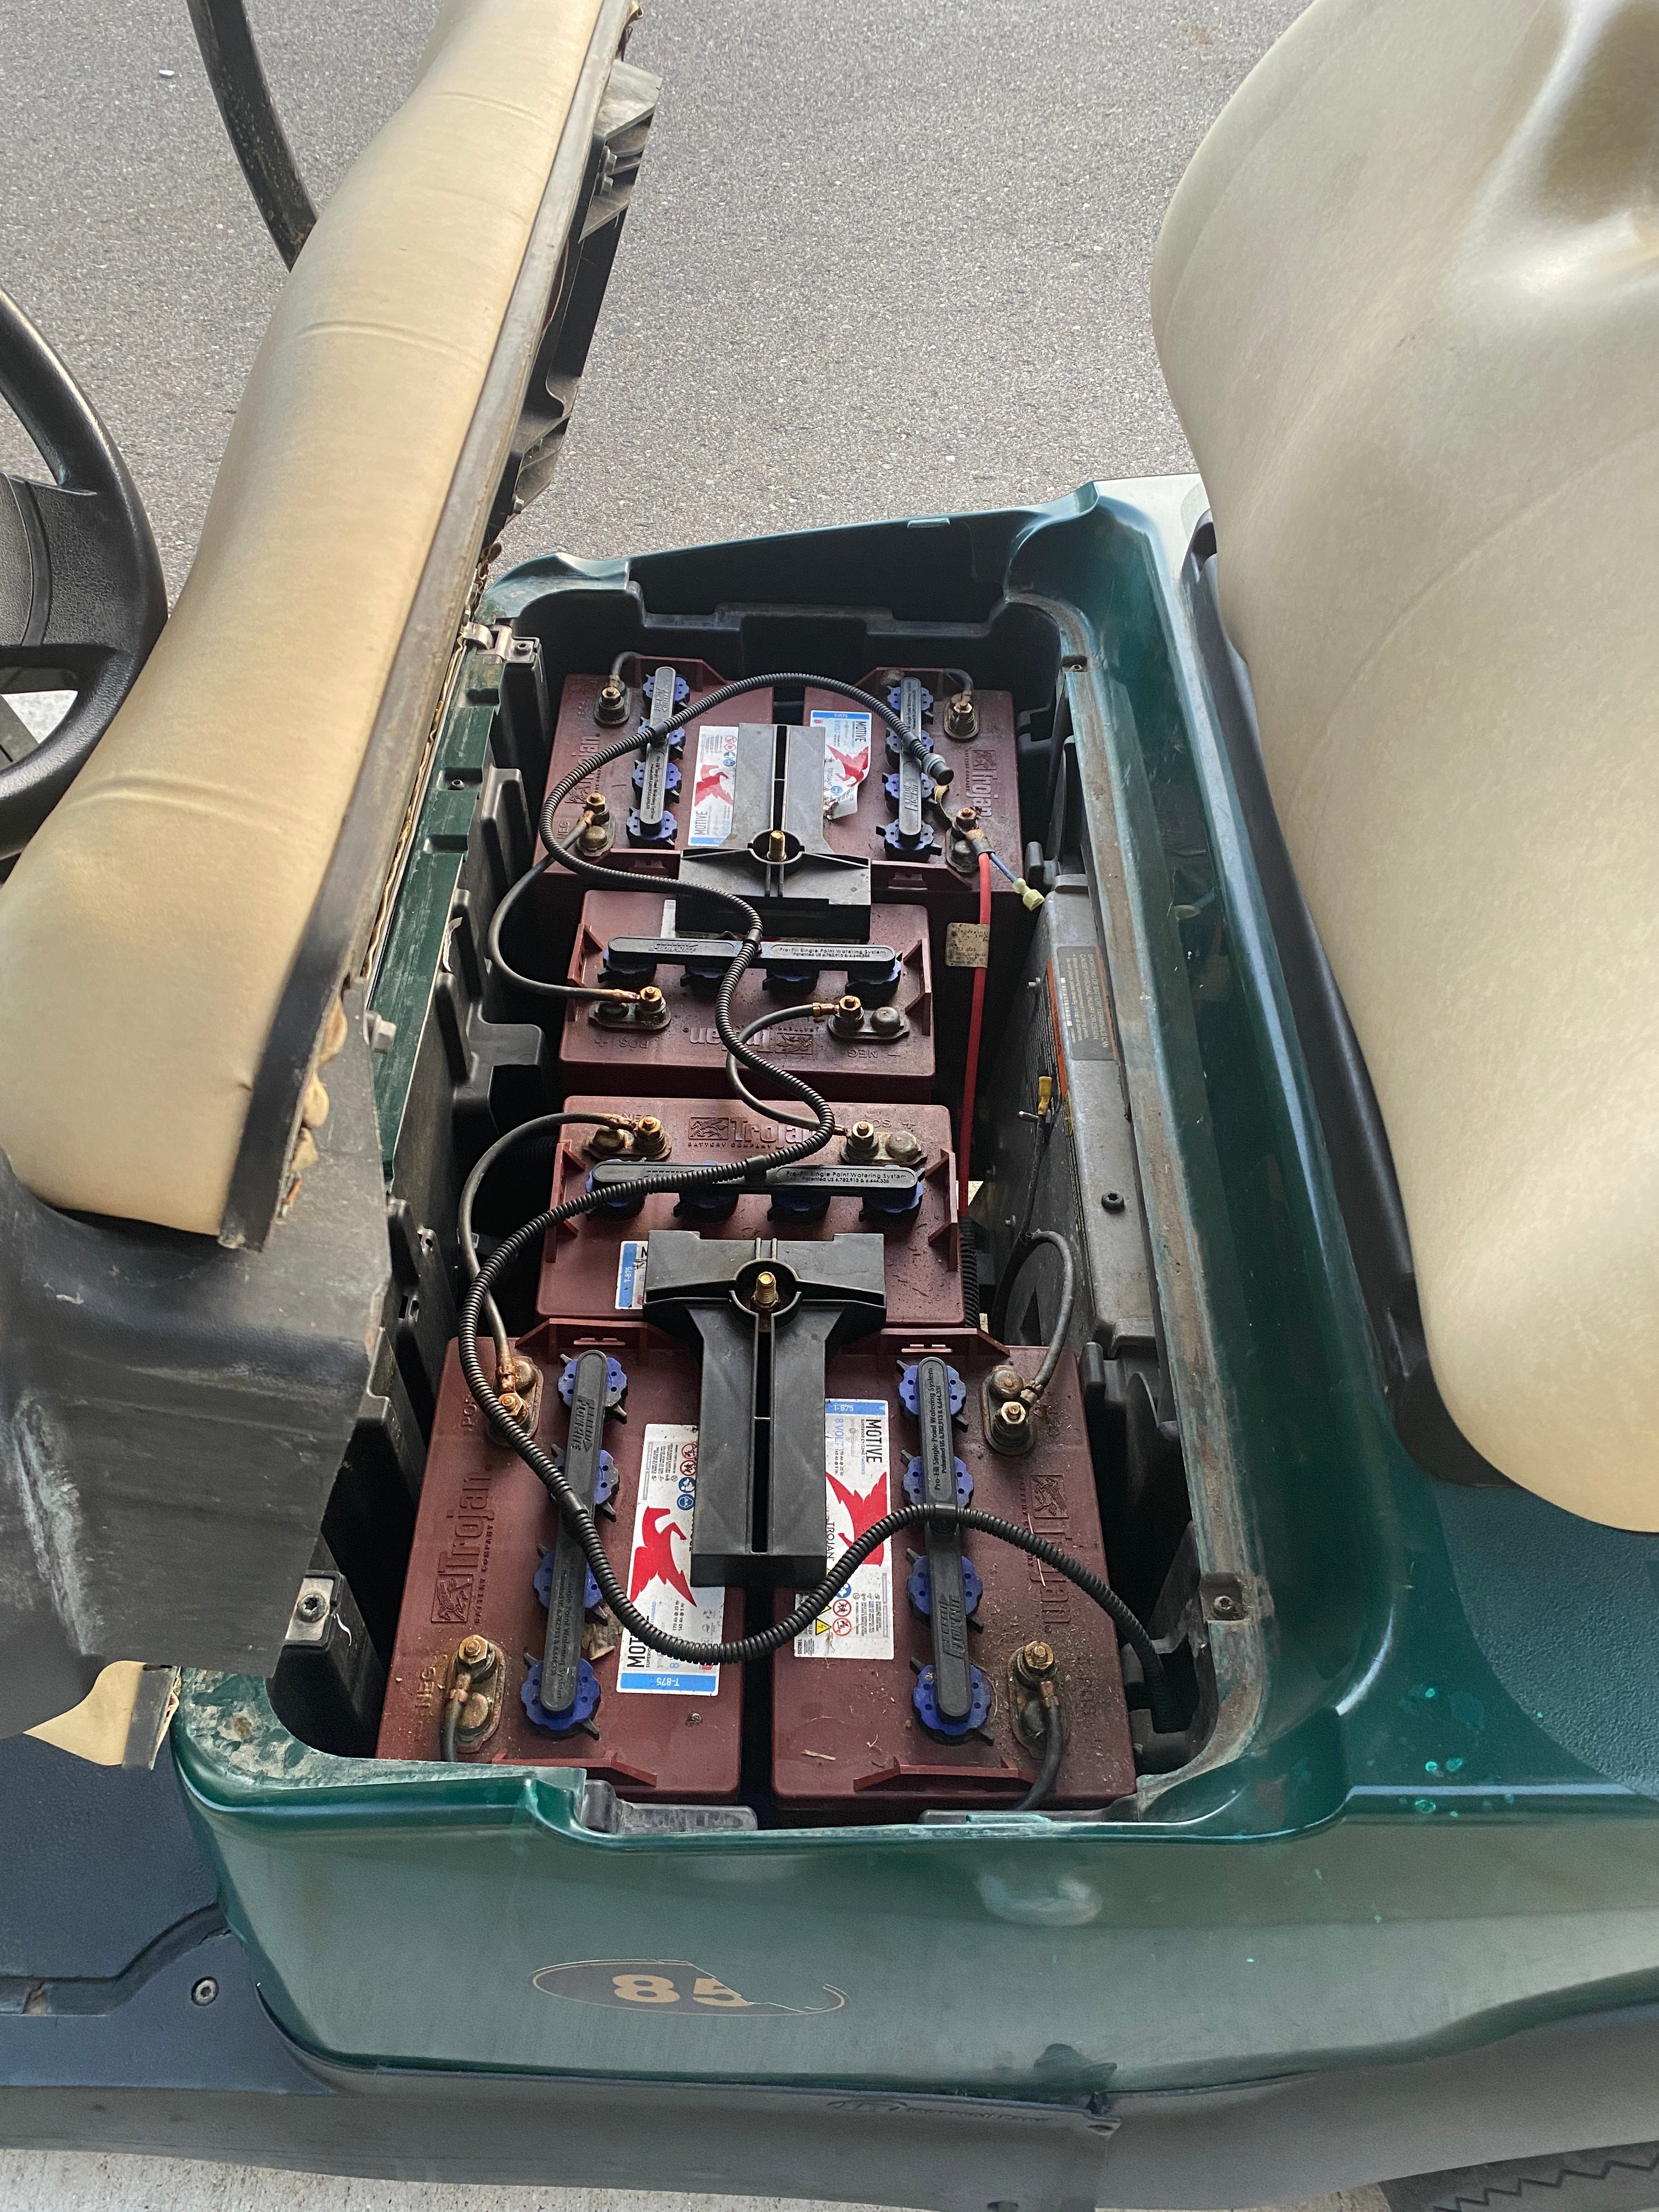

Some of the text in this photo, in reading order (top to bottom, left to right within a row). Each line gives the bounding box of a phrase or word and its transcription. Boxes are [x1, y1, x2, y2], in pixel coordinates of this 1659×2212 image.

[855, 721, 867, 742] MOTIVE
[966, 771, 999, 817] Trojan
[694, 811, 707, 835] MOTIVE
[1080, 953, 1088, 970] CAUSE
[1087, 954, 1097, 978] SHORTING
[1083, 970, 1092, 996] PERSONAL
[1093, 986, 1102, 1007] BATTERY
[1091, 1023, 1099, 1039] DEATH
[1097, 1008, 1107, 1036] TERMINALS
[618, 1037, 649, 1049] POS
[689, 1028, 774, 1053] Tran
[847, 1049, 878, 1058] NEG
[623, 1266, 633, 1283] T-875
[927, 1368, 935, 1391] System
[835, 1425, 844, 1447] VOLT
[866, 1419, 882, 1463] MOTIVE
[437, 1471, 495, 1574] Trojan
[558, 1628, 570, 1666] Watering
[414, 1667, 436, 1708] NEG
[556, 1667, 566, 1699] System
[656, 1677, 680, 1686] T-875
[612, 1973, 753, 2007] 85
